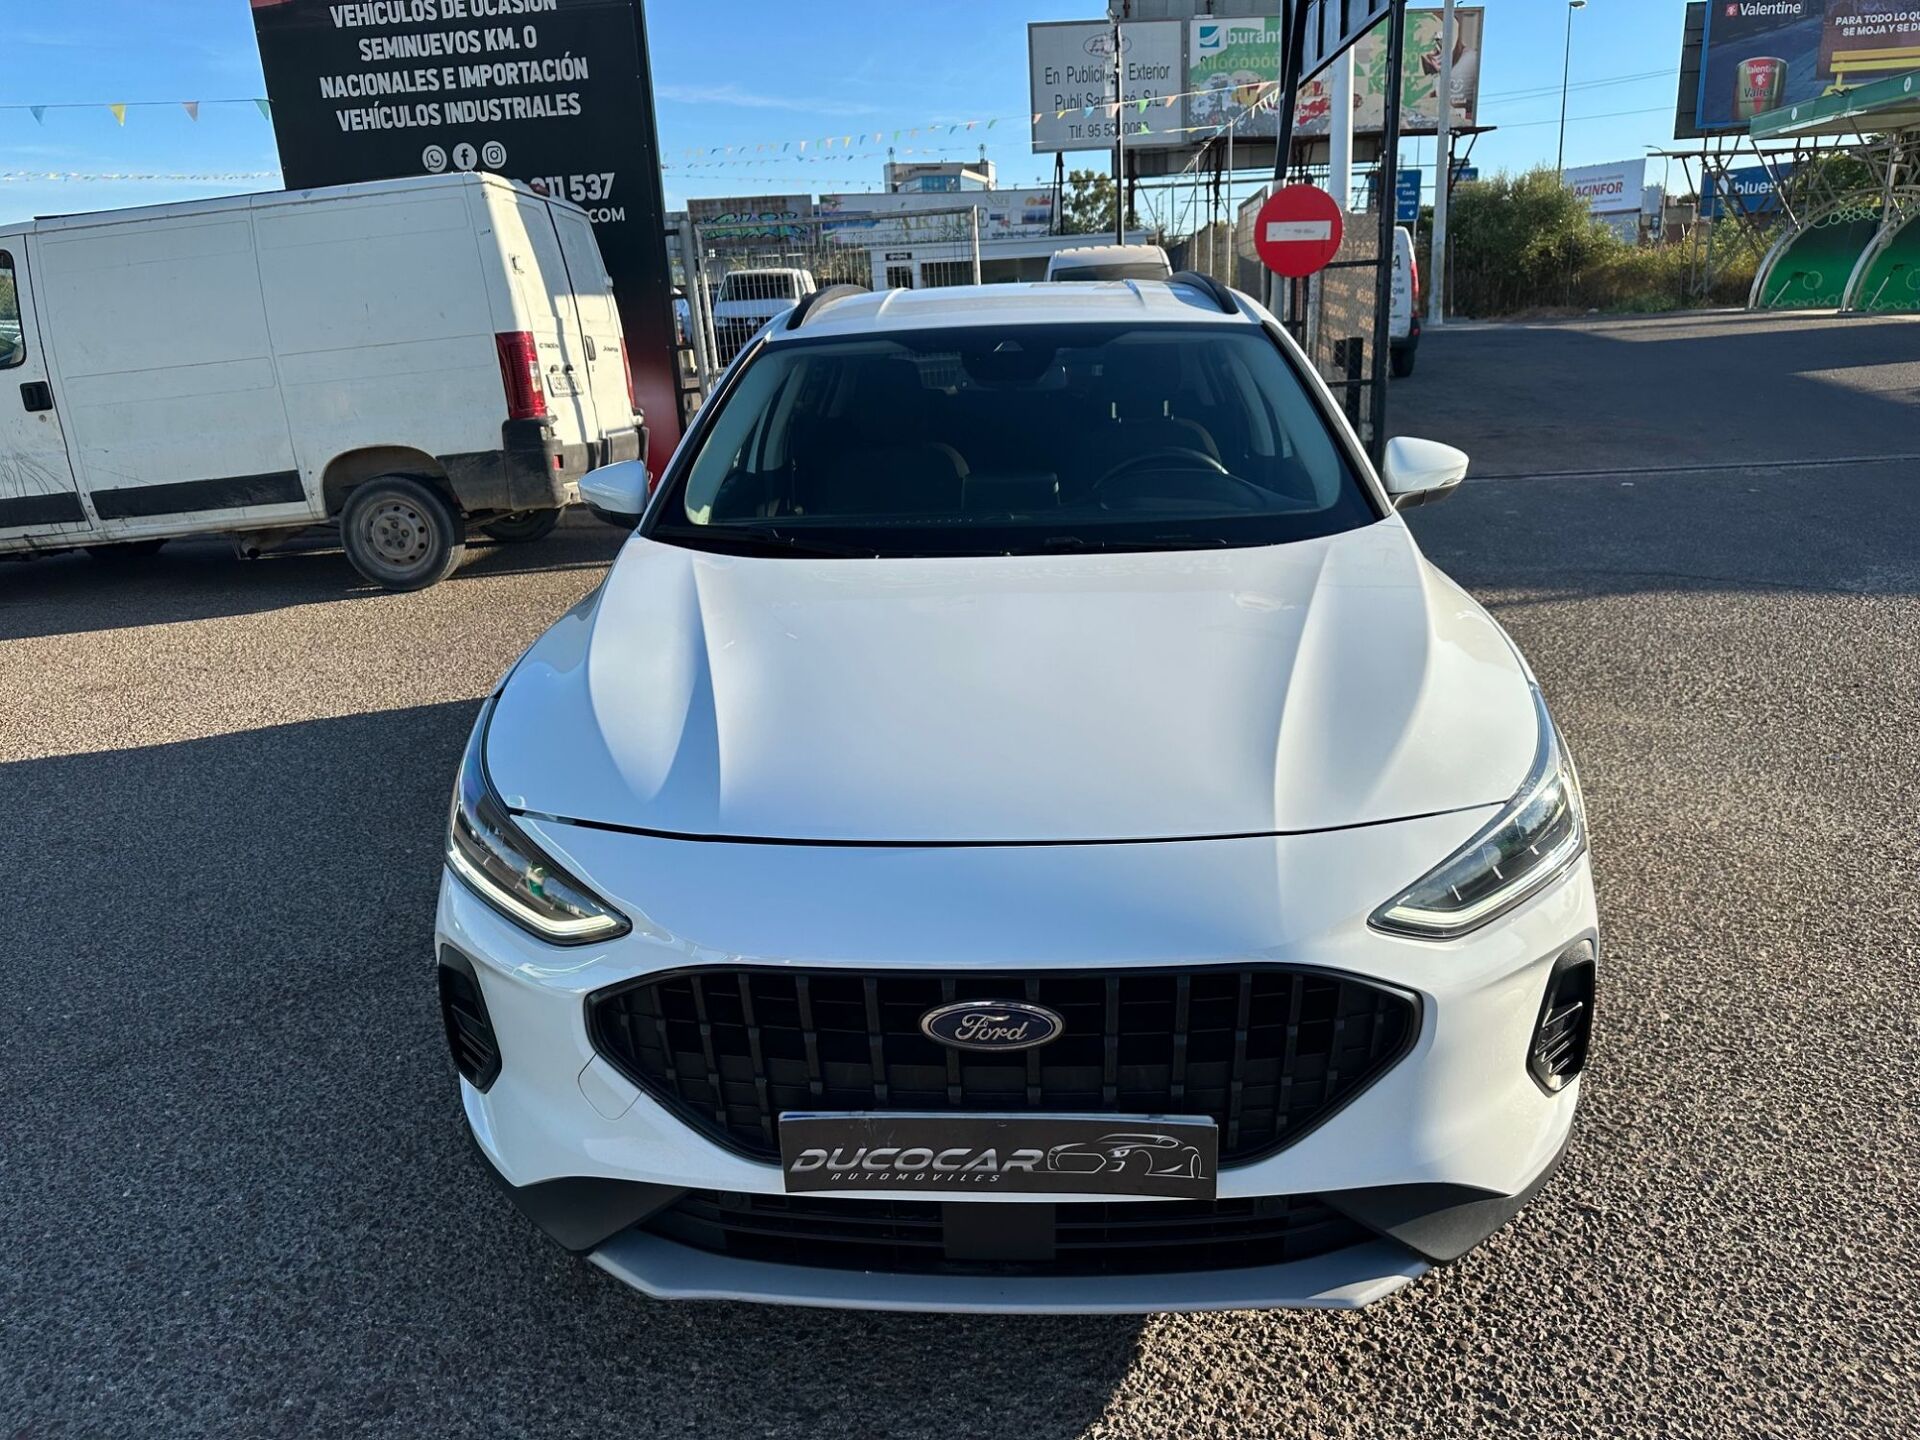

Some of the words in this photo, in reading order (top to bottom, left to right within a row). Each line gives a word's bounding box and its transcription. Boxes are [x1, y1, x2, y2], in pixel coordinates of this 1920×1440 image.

[329, 0, 437, 28] VEHÍCULOS
[441, 0, 468, 19] DE
[1740, 1, 1801, 15] Valentine
[1835, 16, 1863, 26] PARA
[1864, 14, 1893, 24] TODO
[1894, 12, 1907, 22] LO
[1842, 27, 1856, 36] SE
[1857, 26, 1887, 36] MOJA
[1889, 24, 1896, 33] Y
[1896, 23, 1910, 33] SE
[358, 29, 481, 62] SEMINUEVOS
[484, 27, 520, 51] KM.
[319, 68, 440, 98] NACIONALES
[443, 67, 457, 90] E
[459, 51, 589, 89] IMPORTACIÓN
[1045, 67, 1060, 85] En
[1129, 62, 1170, 80] Exterior
[336, 100, 441, 132] VEHÍCULOS
[444, 92, 582, 124] INDUSTRIALES
[1055, 93, 1082, 112] Publi
[1087, 124, 1101, 138] 95
[569, 172, 615, 202] 537
[588, 207, 626, 223] COM
[954, 1013, 1029, 1041] Ford
[790, 1147, 1044, 1173] DUCOCAR
[830, 1173, 1001, 1182] AUTOMÓVILES
